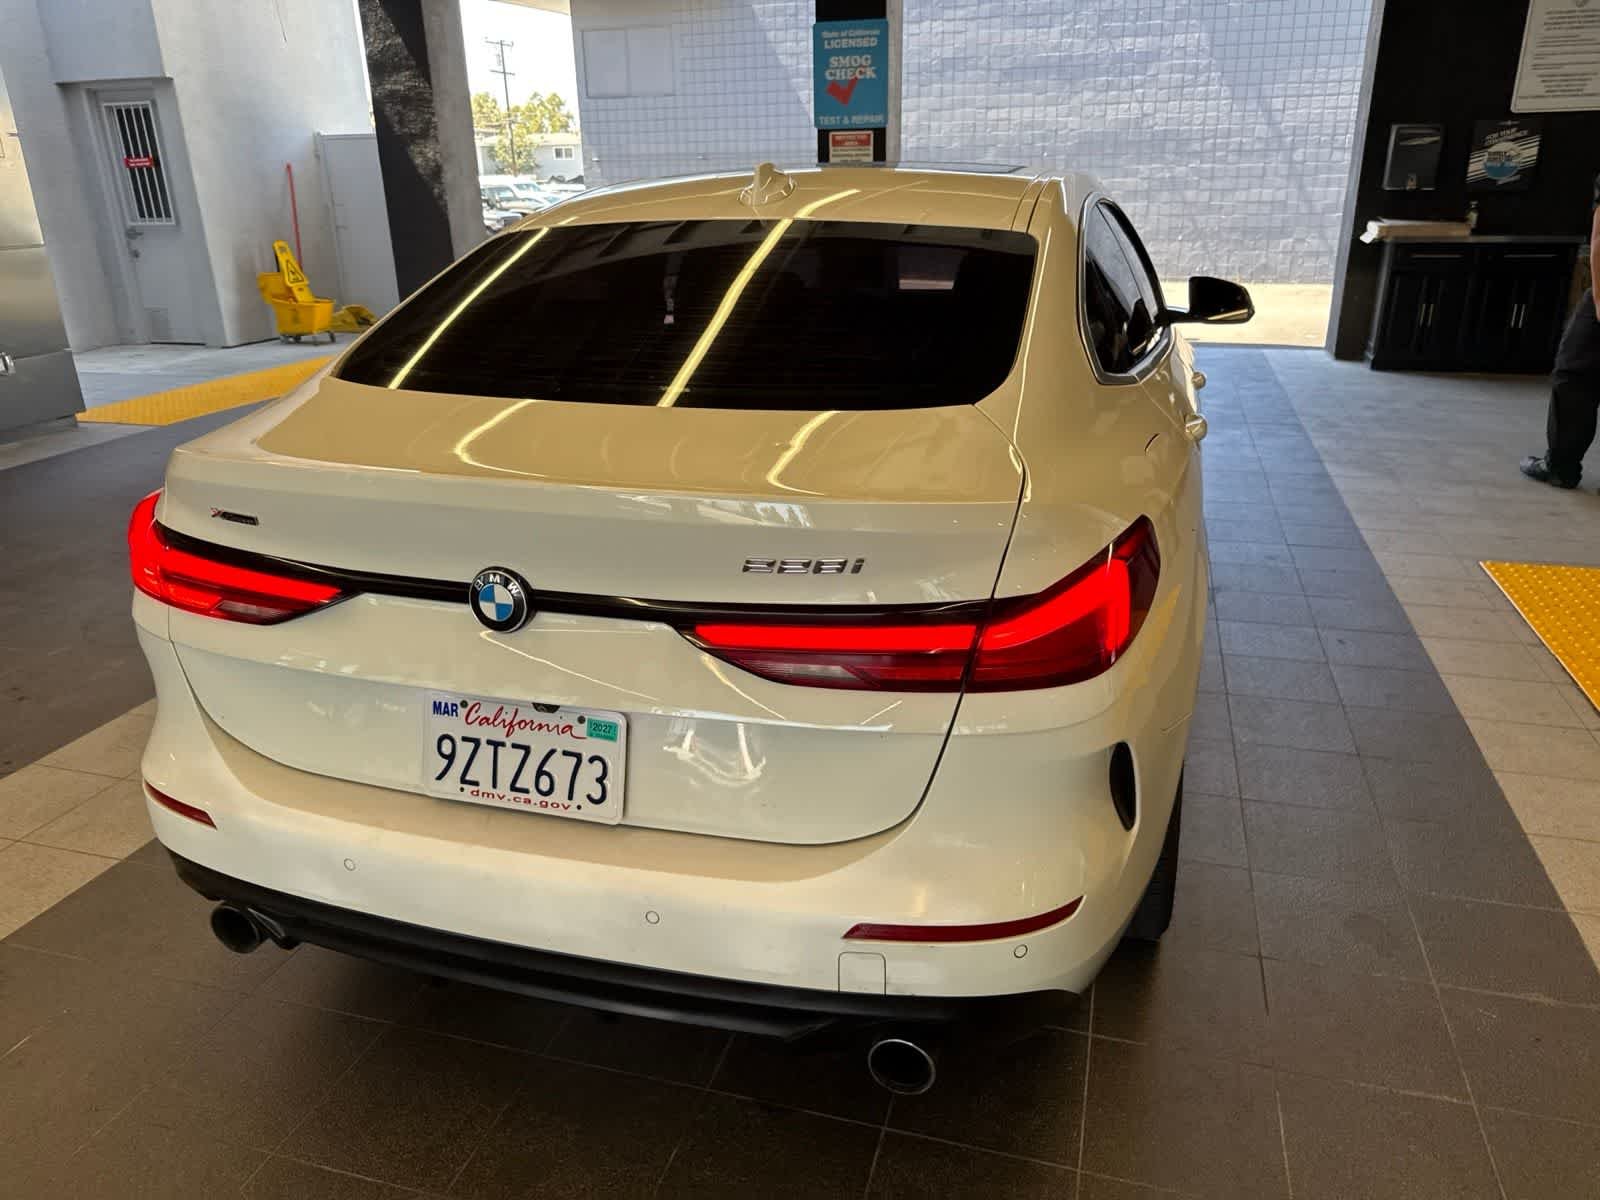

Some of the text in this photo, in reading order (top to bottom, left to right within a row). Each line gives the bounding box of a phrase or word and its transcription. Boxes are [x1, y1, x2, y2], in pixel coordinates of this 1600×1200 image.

[824, 37, 878, 49] LICENSED
[829, 54, 872, 68] SMOG
[825, 66, 877, 80] CHECK
[819, 115, 841, 125] TEST
[474, 573, 520, 597] BMW
[432, 700, 458, 717] MAR
[464, 702, 587, 739] California
[592, 722, 612, 735] 2027
[435, 733, 608, 805] 9ZTZ673
[470, 789, 571, 810] dmv.ca.gov
